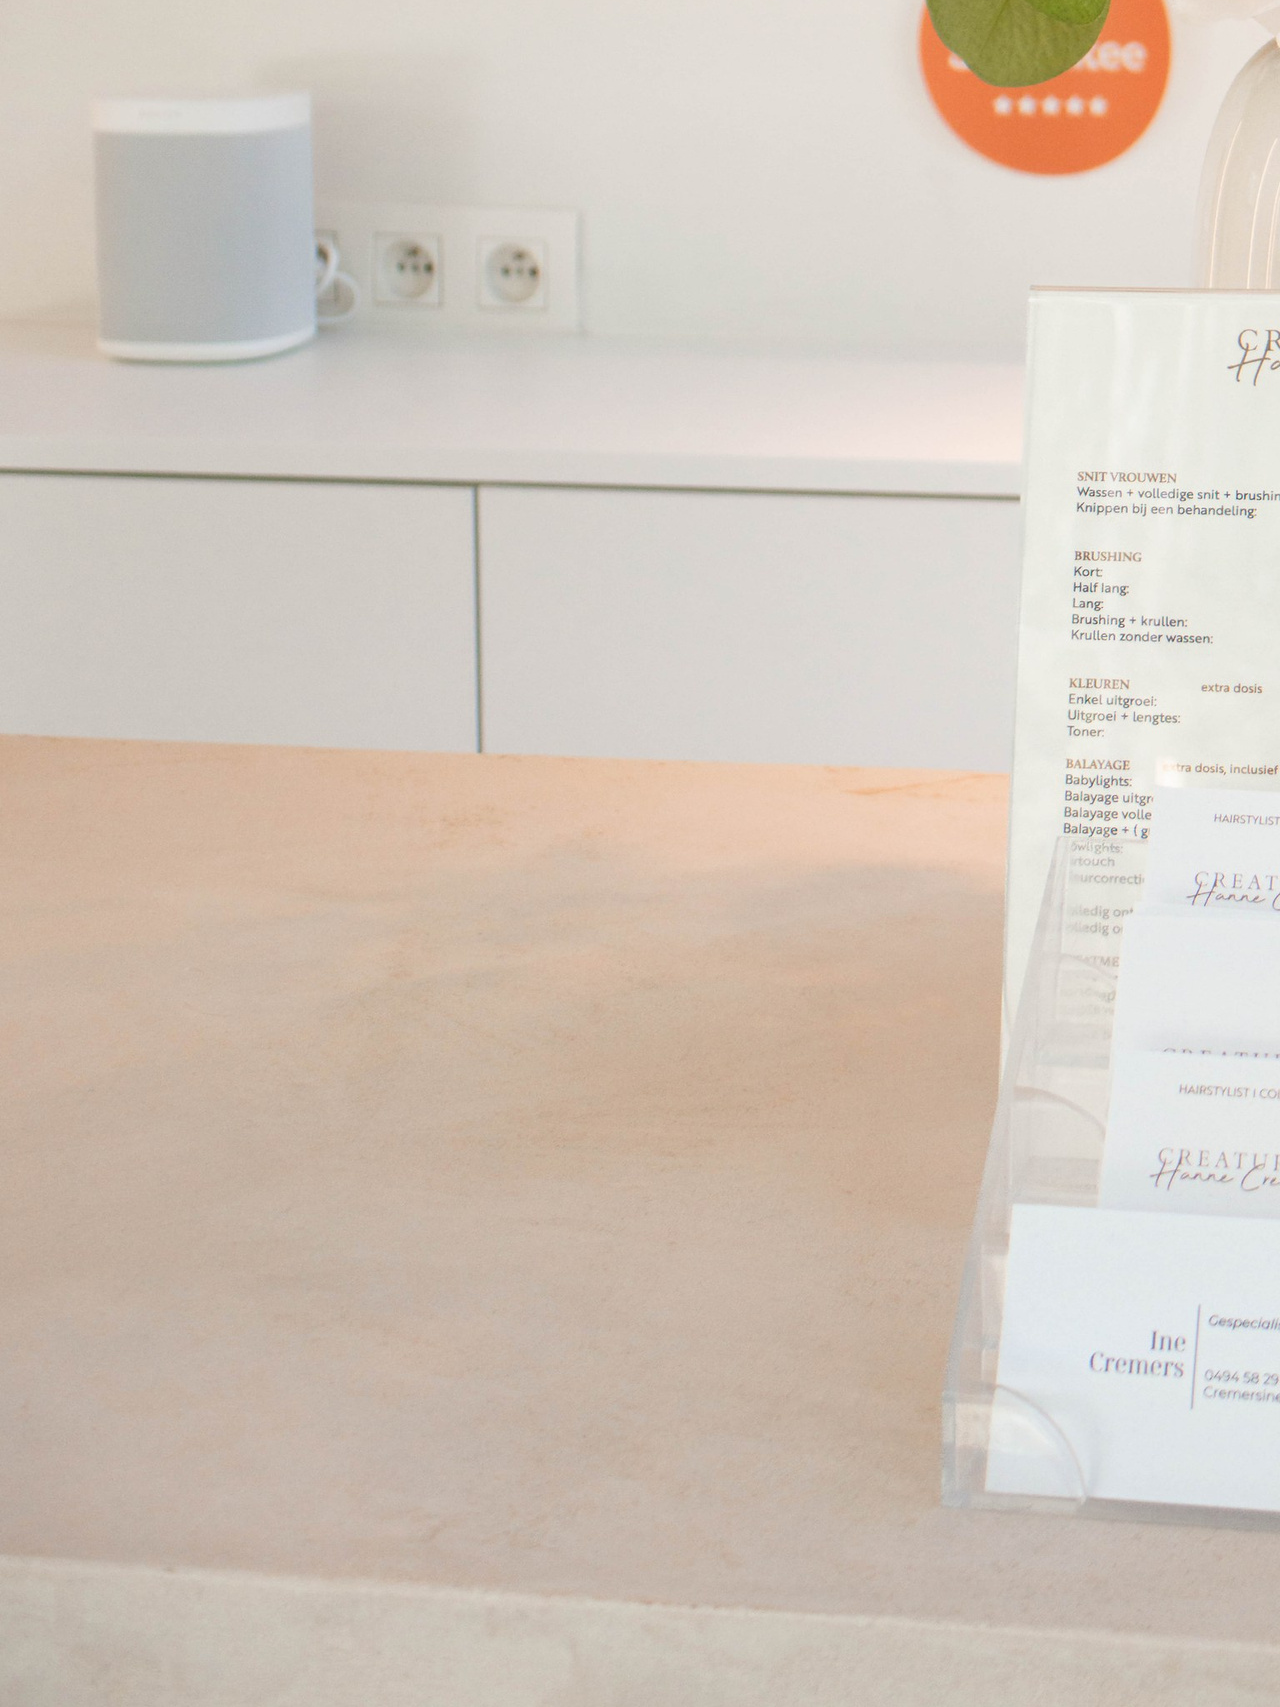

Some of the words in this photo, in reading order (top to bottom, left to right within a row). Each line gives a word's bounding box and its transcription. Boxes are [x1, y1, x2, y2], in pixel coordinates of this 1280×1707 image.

[1077, 471, 1107, 483] SNIT
[1110, 472, 1177, 483] VROUWEN
[1077, 486, 1122, 498] Wassen
[1138, 488, 1194, 501] volledige
[1197, 489, 1220, 500] snit
[1076, 502, 1128, 516] Knippen
[1132, 504, 1147, 516] bij
[1151, 505, 1174, 514] een
[1177, 504, 1257, 519] behandeling:
[1075, 550, 1142, 562] BRUSHING
[1074, 566, 1103, 578] Kort:
[1073, 582, 1098, 593] Half
[1101, 583, 1130, 596] lang:
[1072, 598, 1104, 611] Lang:
[1072, 614, 1125, 628] Brushing
[1141, 615, 1188, 628] krullen:
[1071, 629, 1116, 641] Krullen
[1119, 631, 1163, 643] zonder
[1166, 633, 1214, 644] wassen:
[1069, 678, 1130, 690] KLEUREN
[1201, 682, 1230, 693] extra
[1234, 682, 1263, 694] dosis
[1069, 694, 1102, 705] Enkel
[1106, 695, 1157, 709] uitgroei:
[1068, 710, 1117, 724] Uitgroei
[1133, 712, 1181, 726] lengtes:
[1067, 726, 1105, 738] Toner:
[1066, 759, 1130, 771] BALAYAGE
[1195, 762, 1227, 775] dosis,
[1230, 763, 1279, 775] inclusief
[1065, 774, 1132, 788] Babylights:
[1064, 790, 1119, 804] Balayage
[1123, 792, 1153, 805] uitgr
[1064, 807, 1119, 821] Balayage
[1214, 813, 1280, 826] HAIRSTYLIST
[1063, 823, 1118, 837] Balayage
[1179, 1084, 1250, 1098] HAIRSTYLIST
[1150, 1330, 1186, 1352] Ine
[1089, 1351, 1185, 1379] Cremers
[1204, 1368, 1240, 1383] 0494
[1243, 1371, 1259, 1385] 58
[1262, 1373, 1279, 1386] 29
